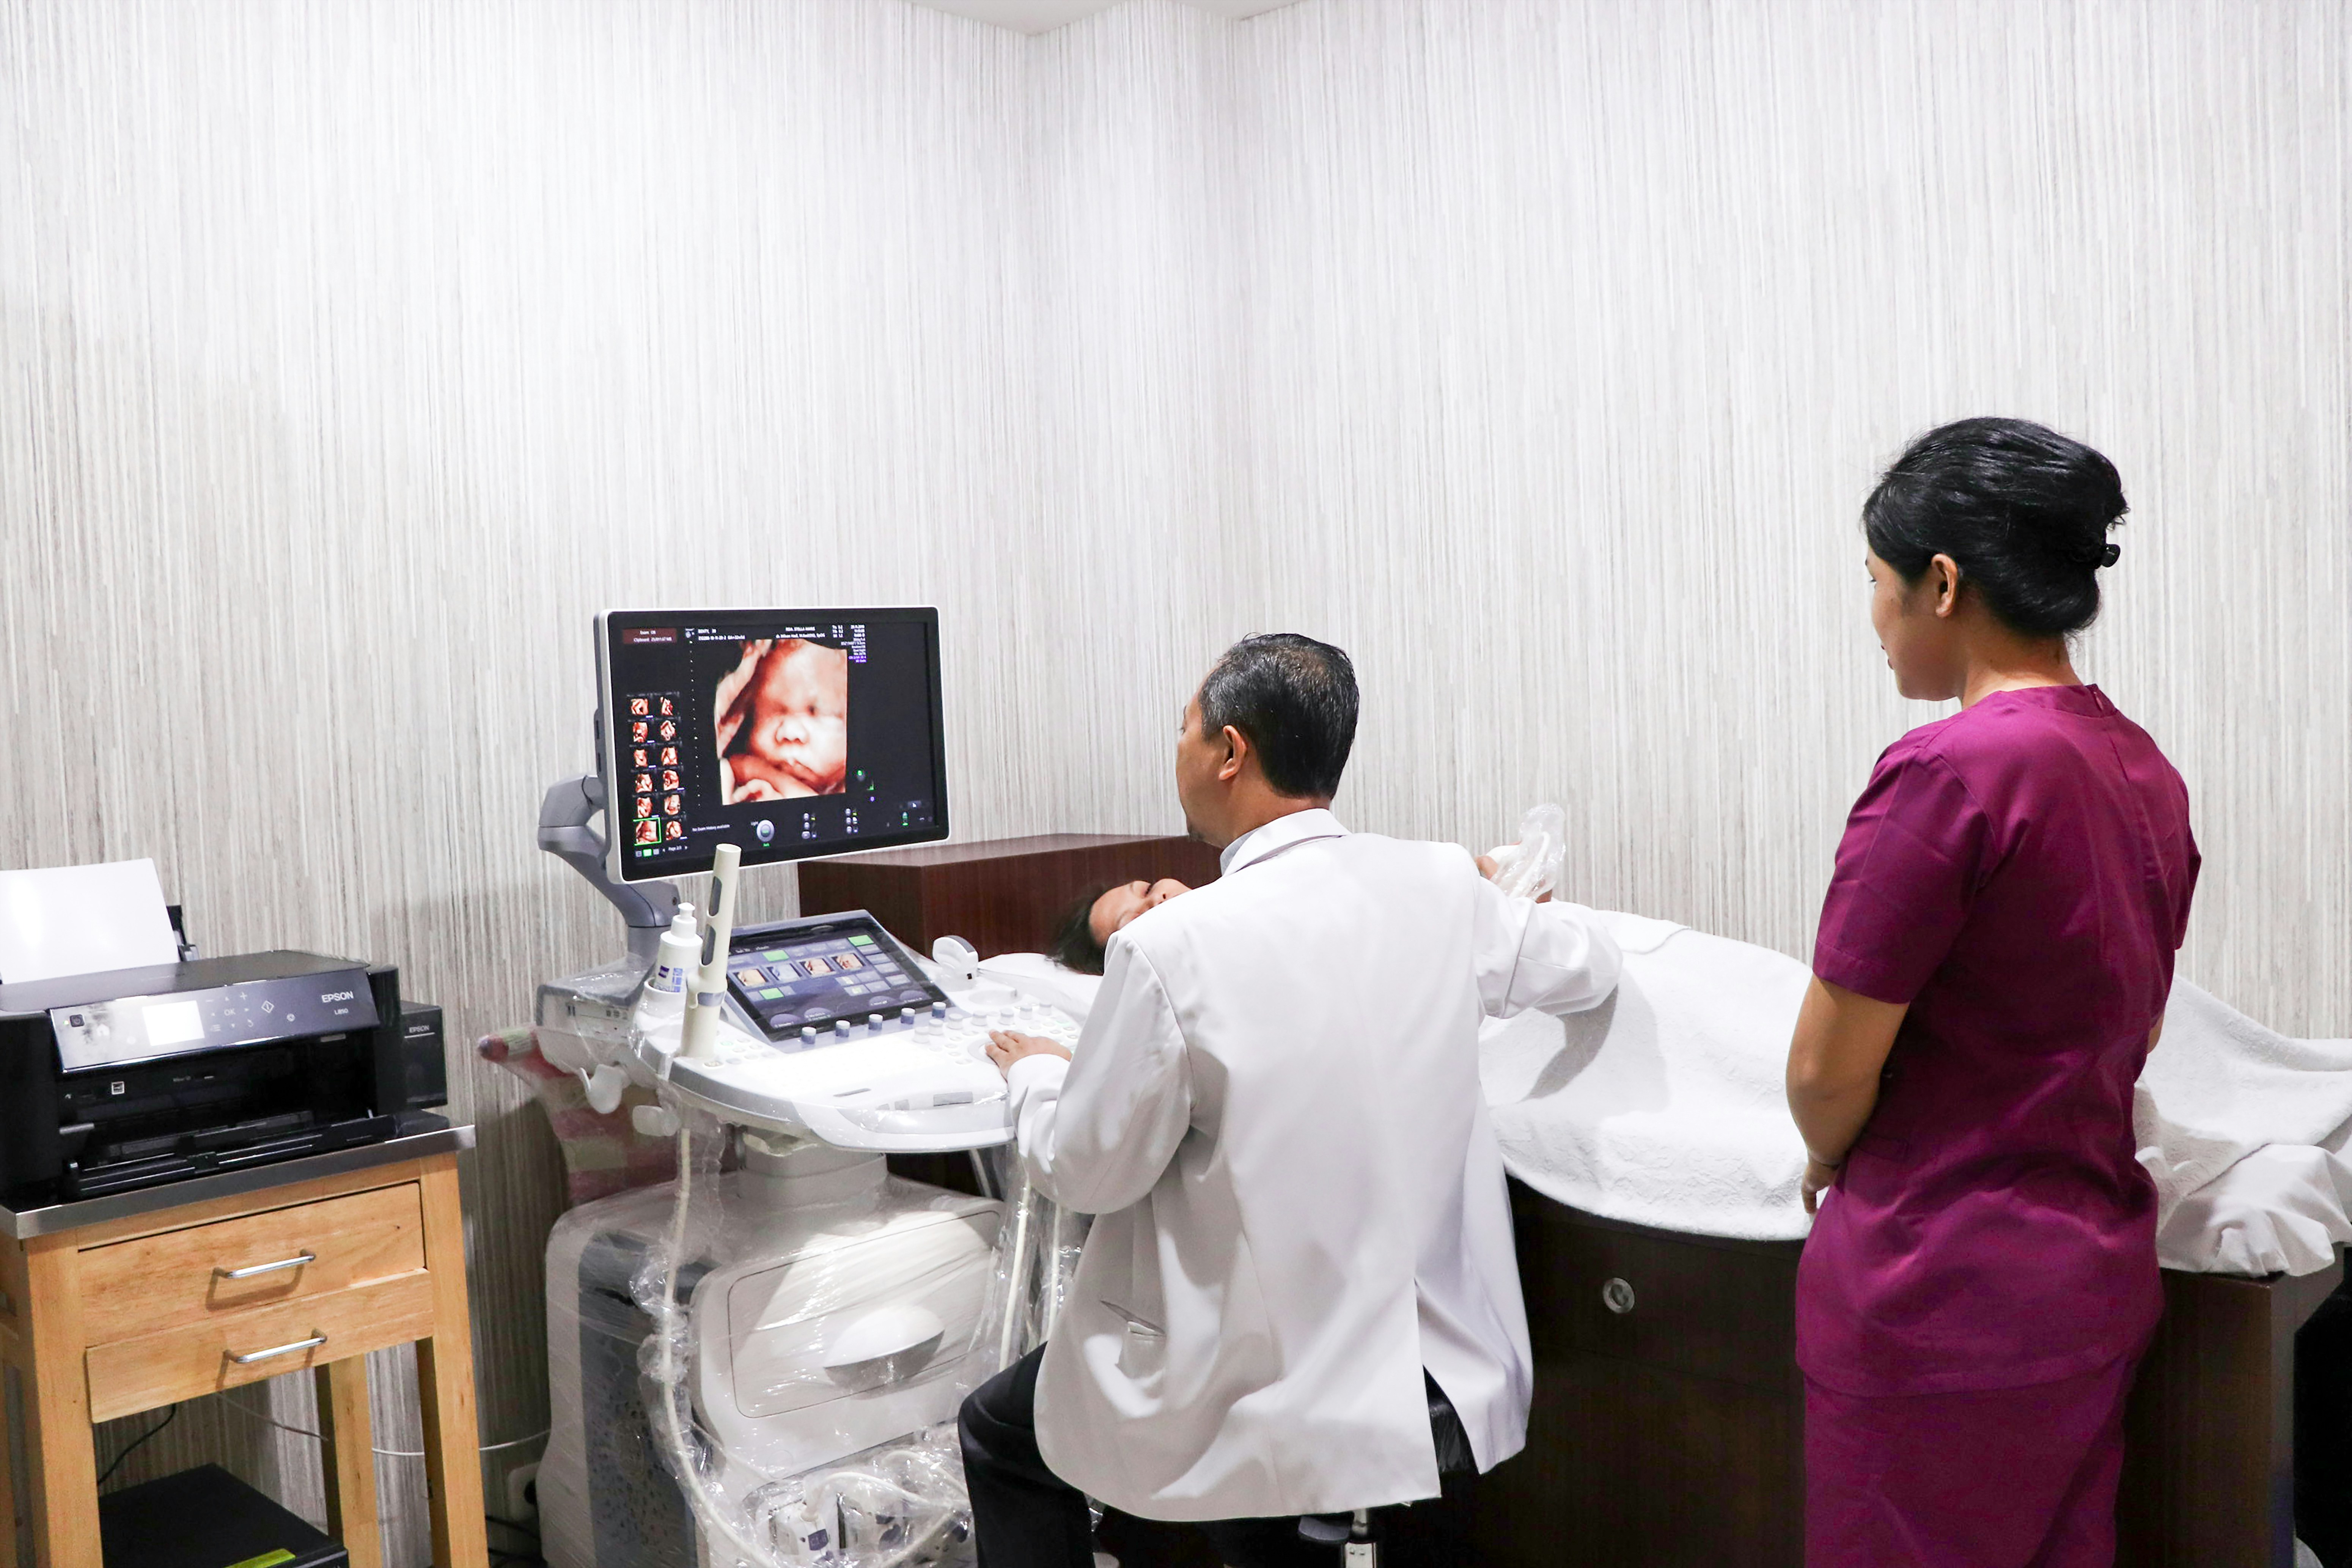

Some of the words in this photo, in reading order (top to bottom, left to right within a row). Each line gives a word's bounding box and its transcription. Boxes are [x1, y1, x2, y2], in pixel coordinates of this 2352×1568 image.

[321, 991, 354, 1003] EPSON
[223, 1008, 236, 1016] OK
[409, 1025, 430, 1033] EPSON
